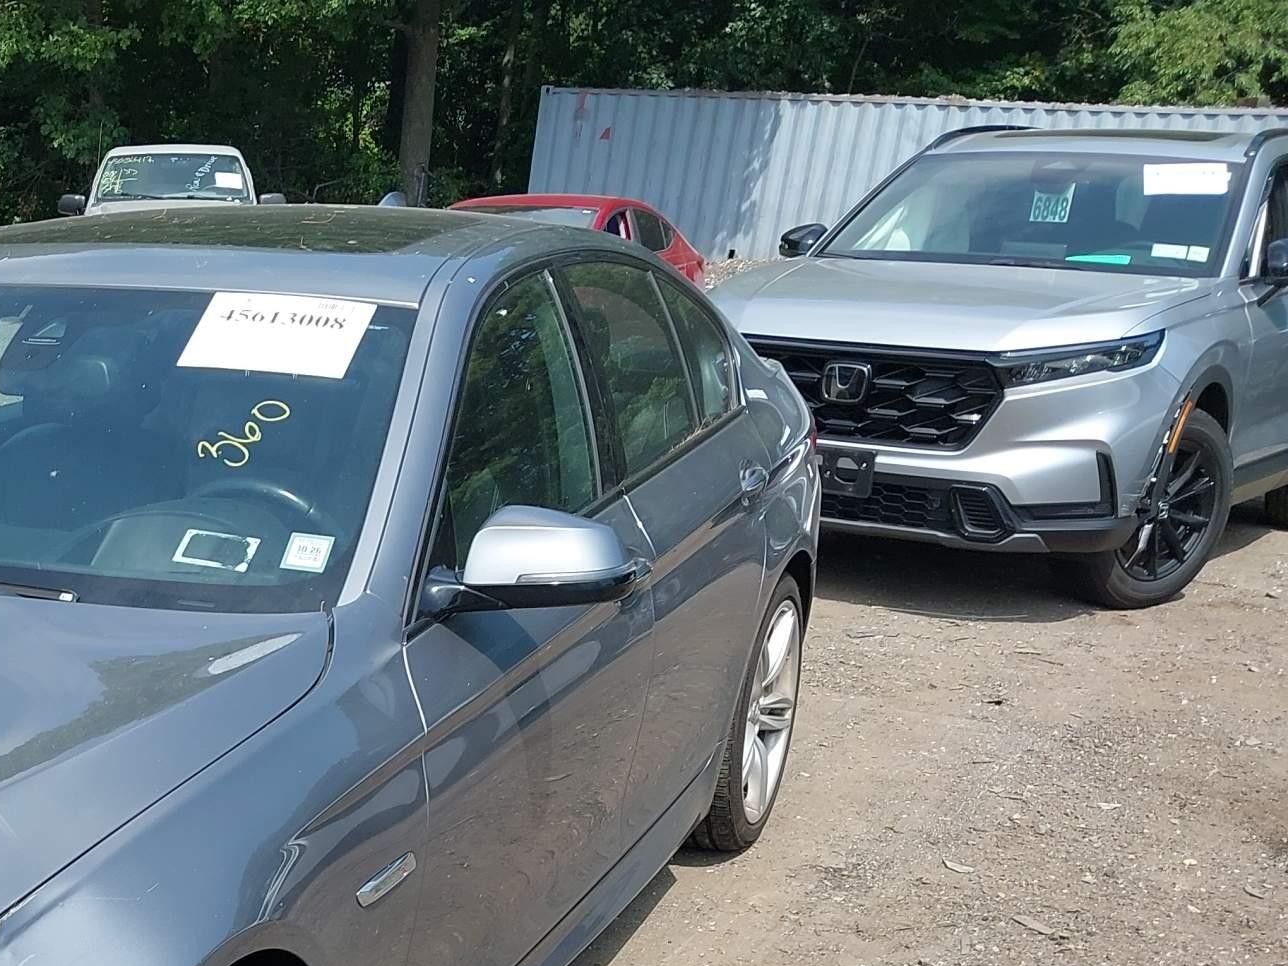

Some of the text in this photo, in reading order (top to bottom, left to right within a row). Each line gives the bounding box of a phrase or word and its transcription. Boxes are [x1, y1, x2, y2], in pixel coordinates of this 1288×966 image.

[1032, 195, 1069, 221] 6848
[220, 309, 347, 330] 45613008
[197, 400, 291, 467] 360
